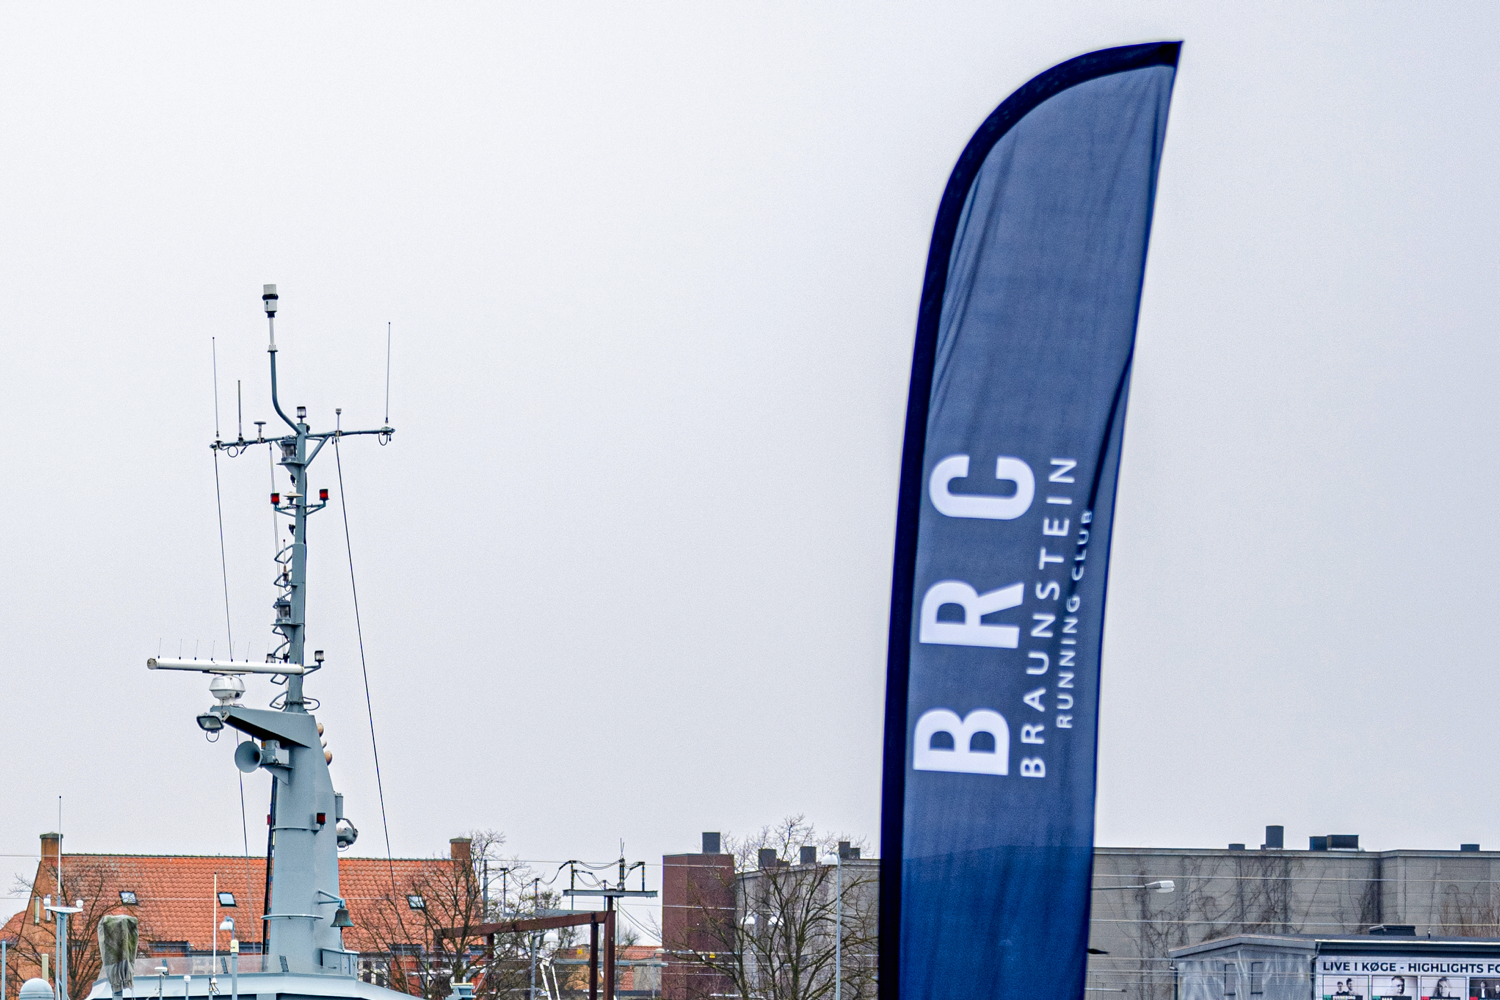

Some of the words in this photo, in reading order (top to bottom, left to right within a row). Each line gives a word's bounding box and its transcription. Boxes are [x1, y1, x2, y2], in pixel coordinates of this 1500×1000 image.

[1020, 458, 1077, 778] BRAUNSTEIN
[1056, 595, 1081, 728] RUNNING
[1071, 510, 1093, 581] CLUB
[1323, 962, 1350, 971] LIVE
[1362, 962, 1396, 972] KØGE
[1408, 963, 1484, 973] HIGHLIGHTS
